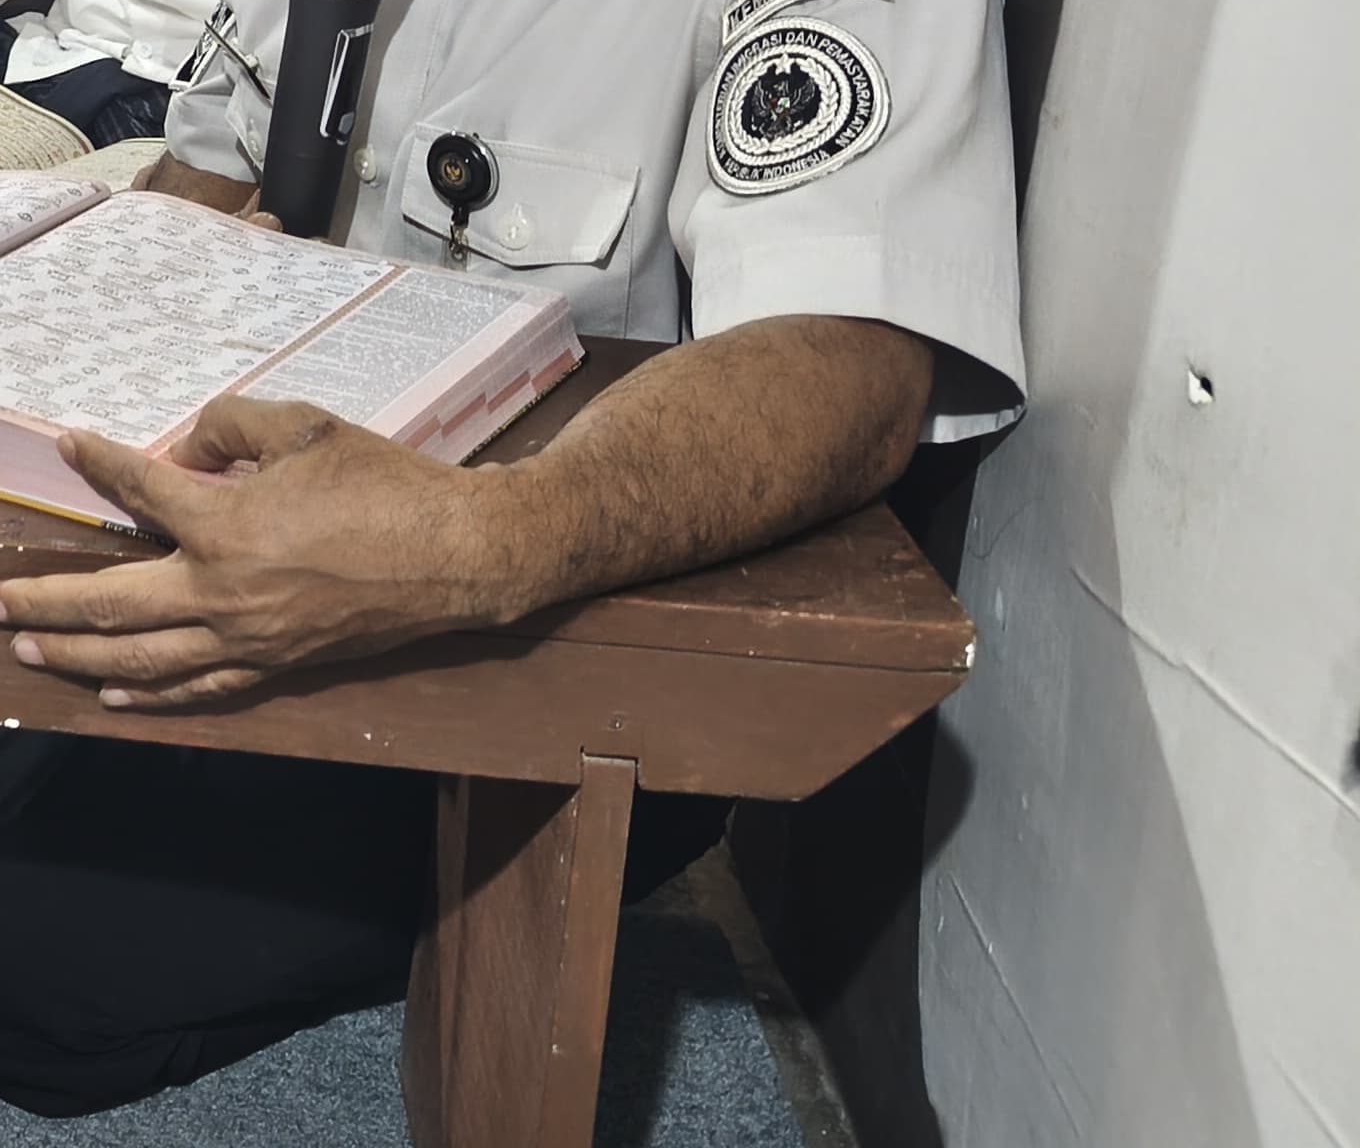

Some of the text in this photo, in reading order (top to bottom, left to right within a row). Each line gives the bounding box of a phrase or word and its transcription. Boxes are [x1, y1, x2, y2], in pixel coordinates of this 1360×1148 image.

[731, 32, 782, 74] IMIGRASI
[785, 31, 818, 47] DAN
[817, 38, 871, 148] PEMASYARAKATAN
[762, 149, 830, 180] INDONESIA
